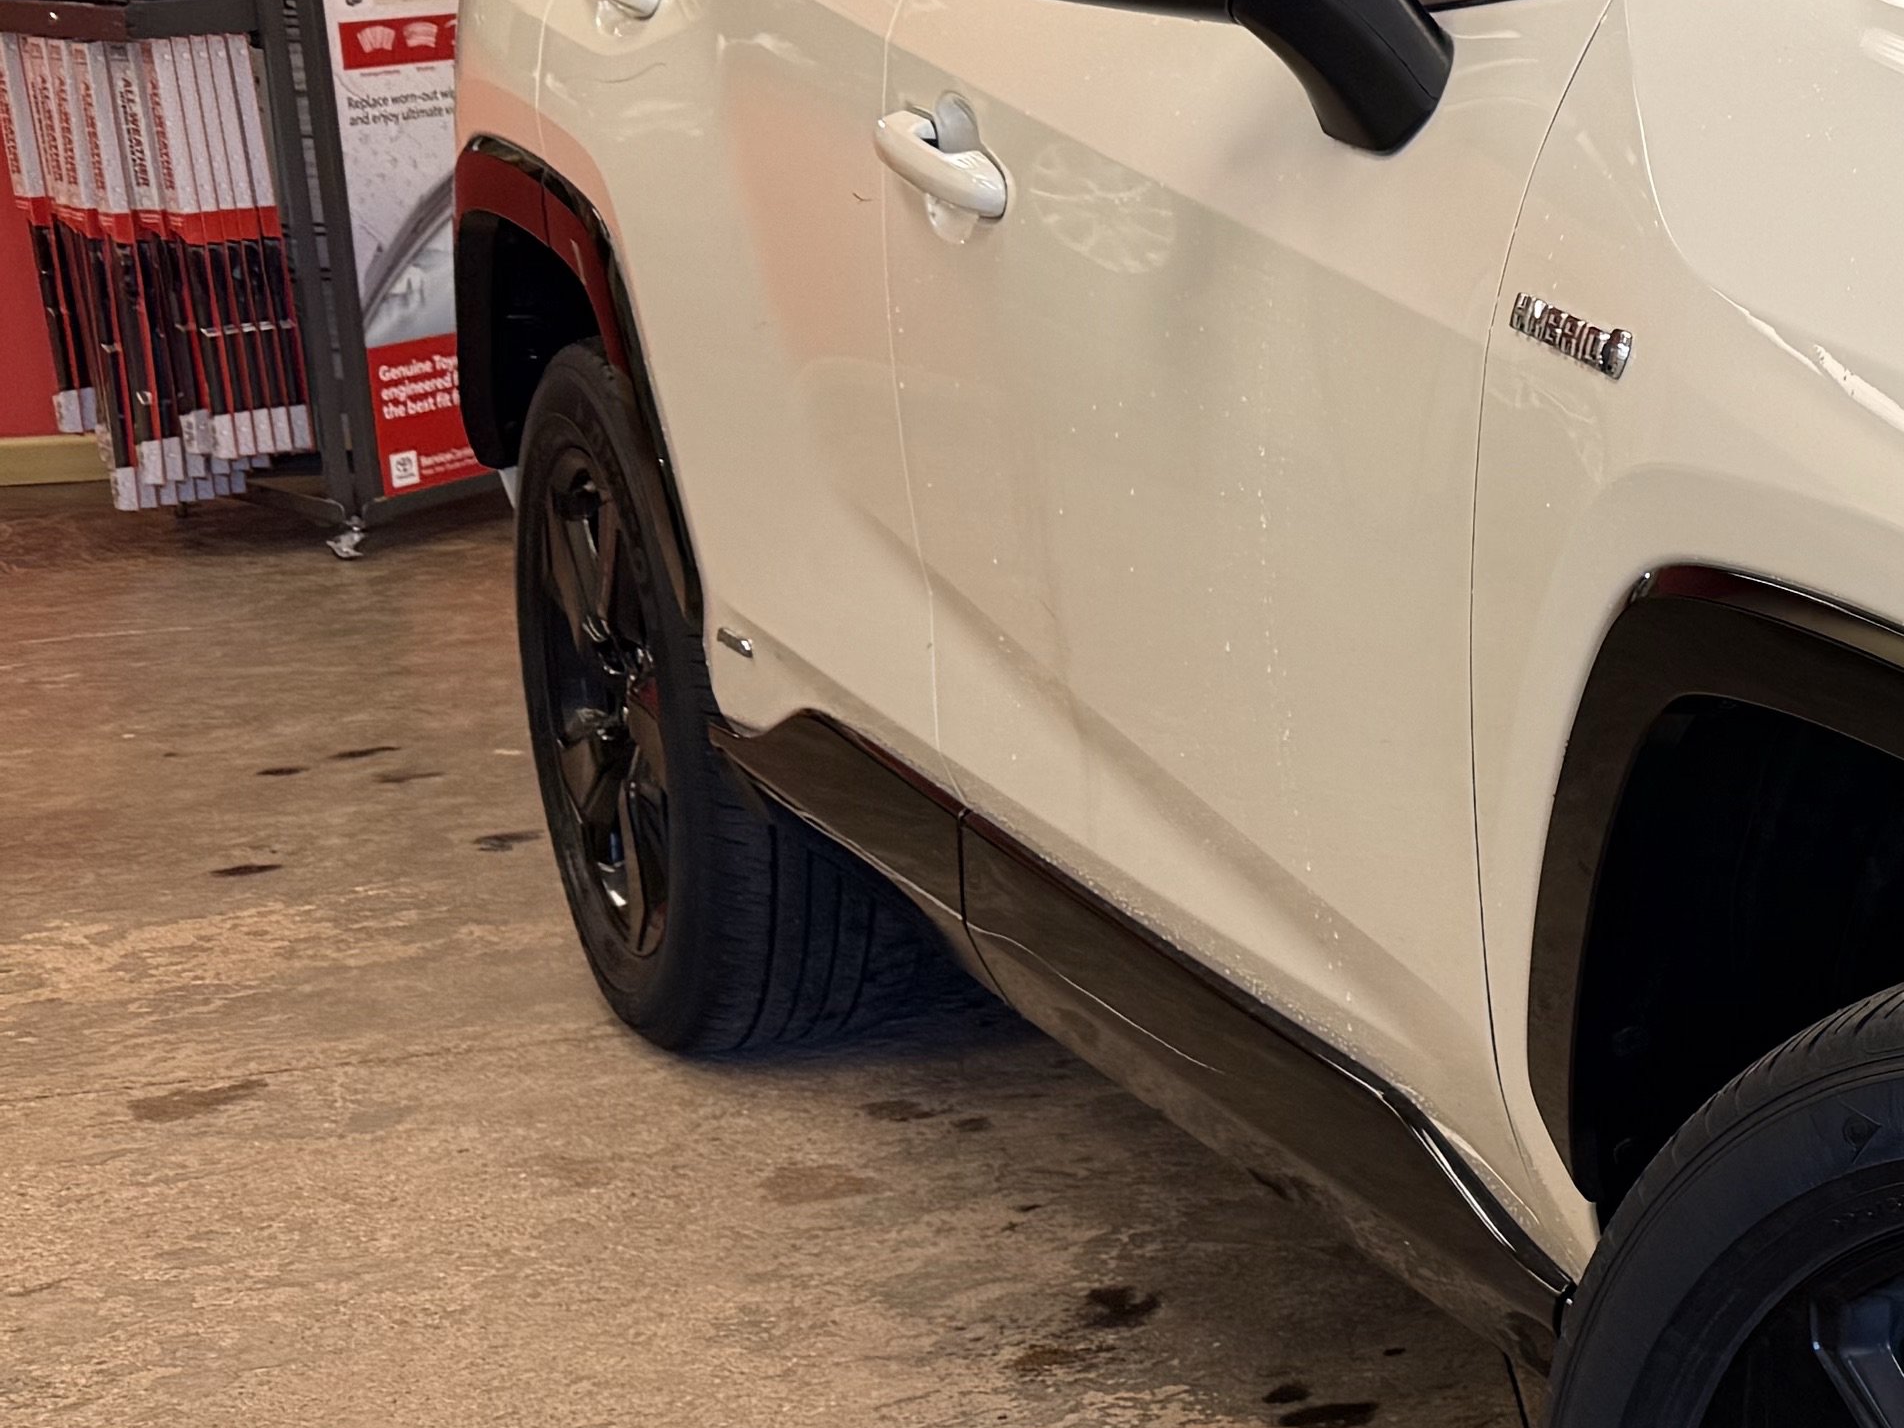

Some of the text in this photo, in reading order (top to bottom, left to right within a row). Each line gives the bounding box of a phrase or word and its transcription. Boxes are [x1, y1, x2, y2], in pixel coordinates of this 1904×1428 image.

[347, 94, 389, 112] Replace
[391, 90, 439, 106] worn-out
[121, 77, 150, 187] ALL-WEATHER
[349, 114, 369, 127] and
[1509, 291, 1613, 373] HYBRID
[379, 358, 433, 382] Genuine
[381, 372, 453, 402] engineered
[382, 401, 406, 420] the
[407, 396, 436, 415] best
[436, 392, 453, 408] fit
